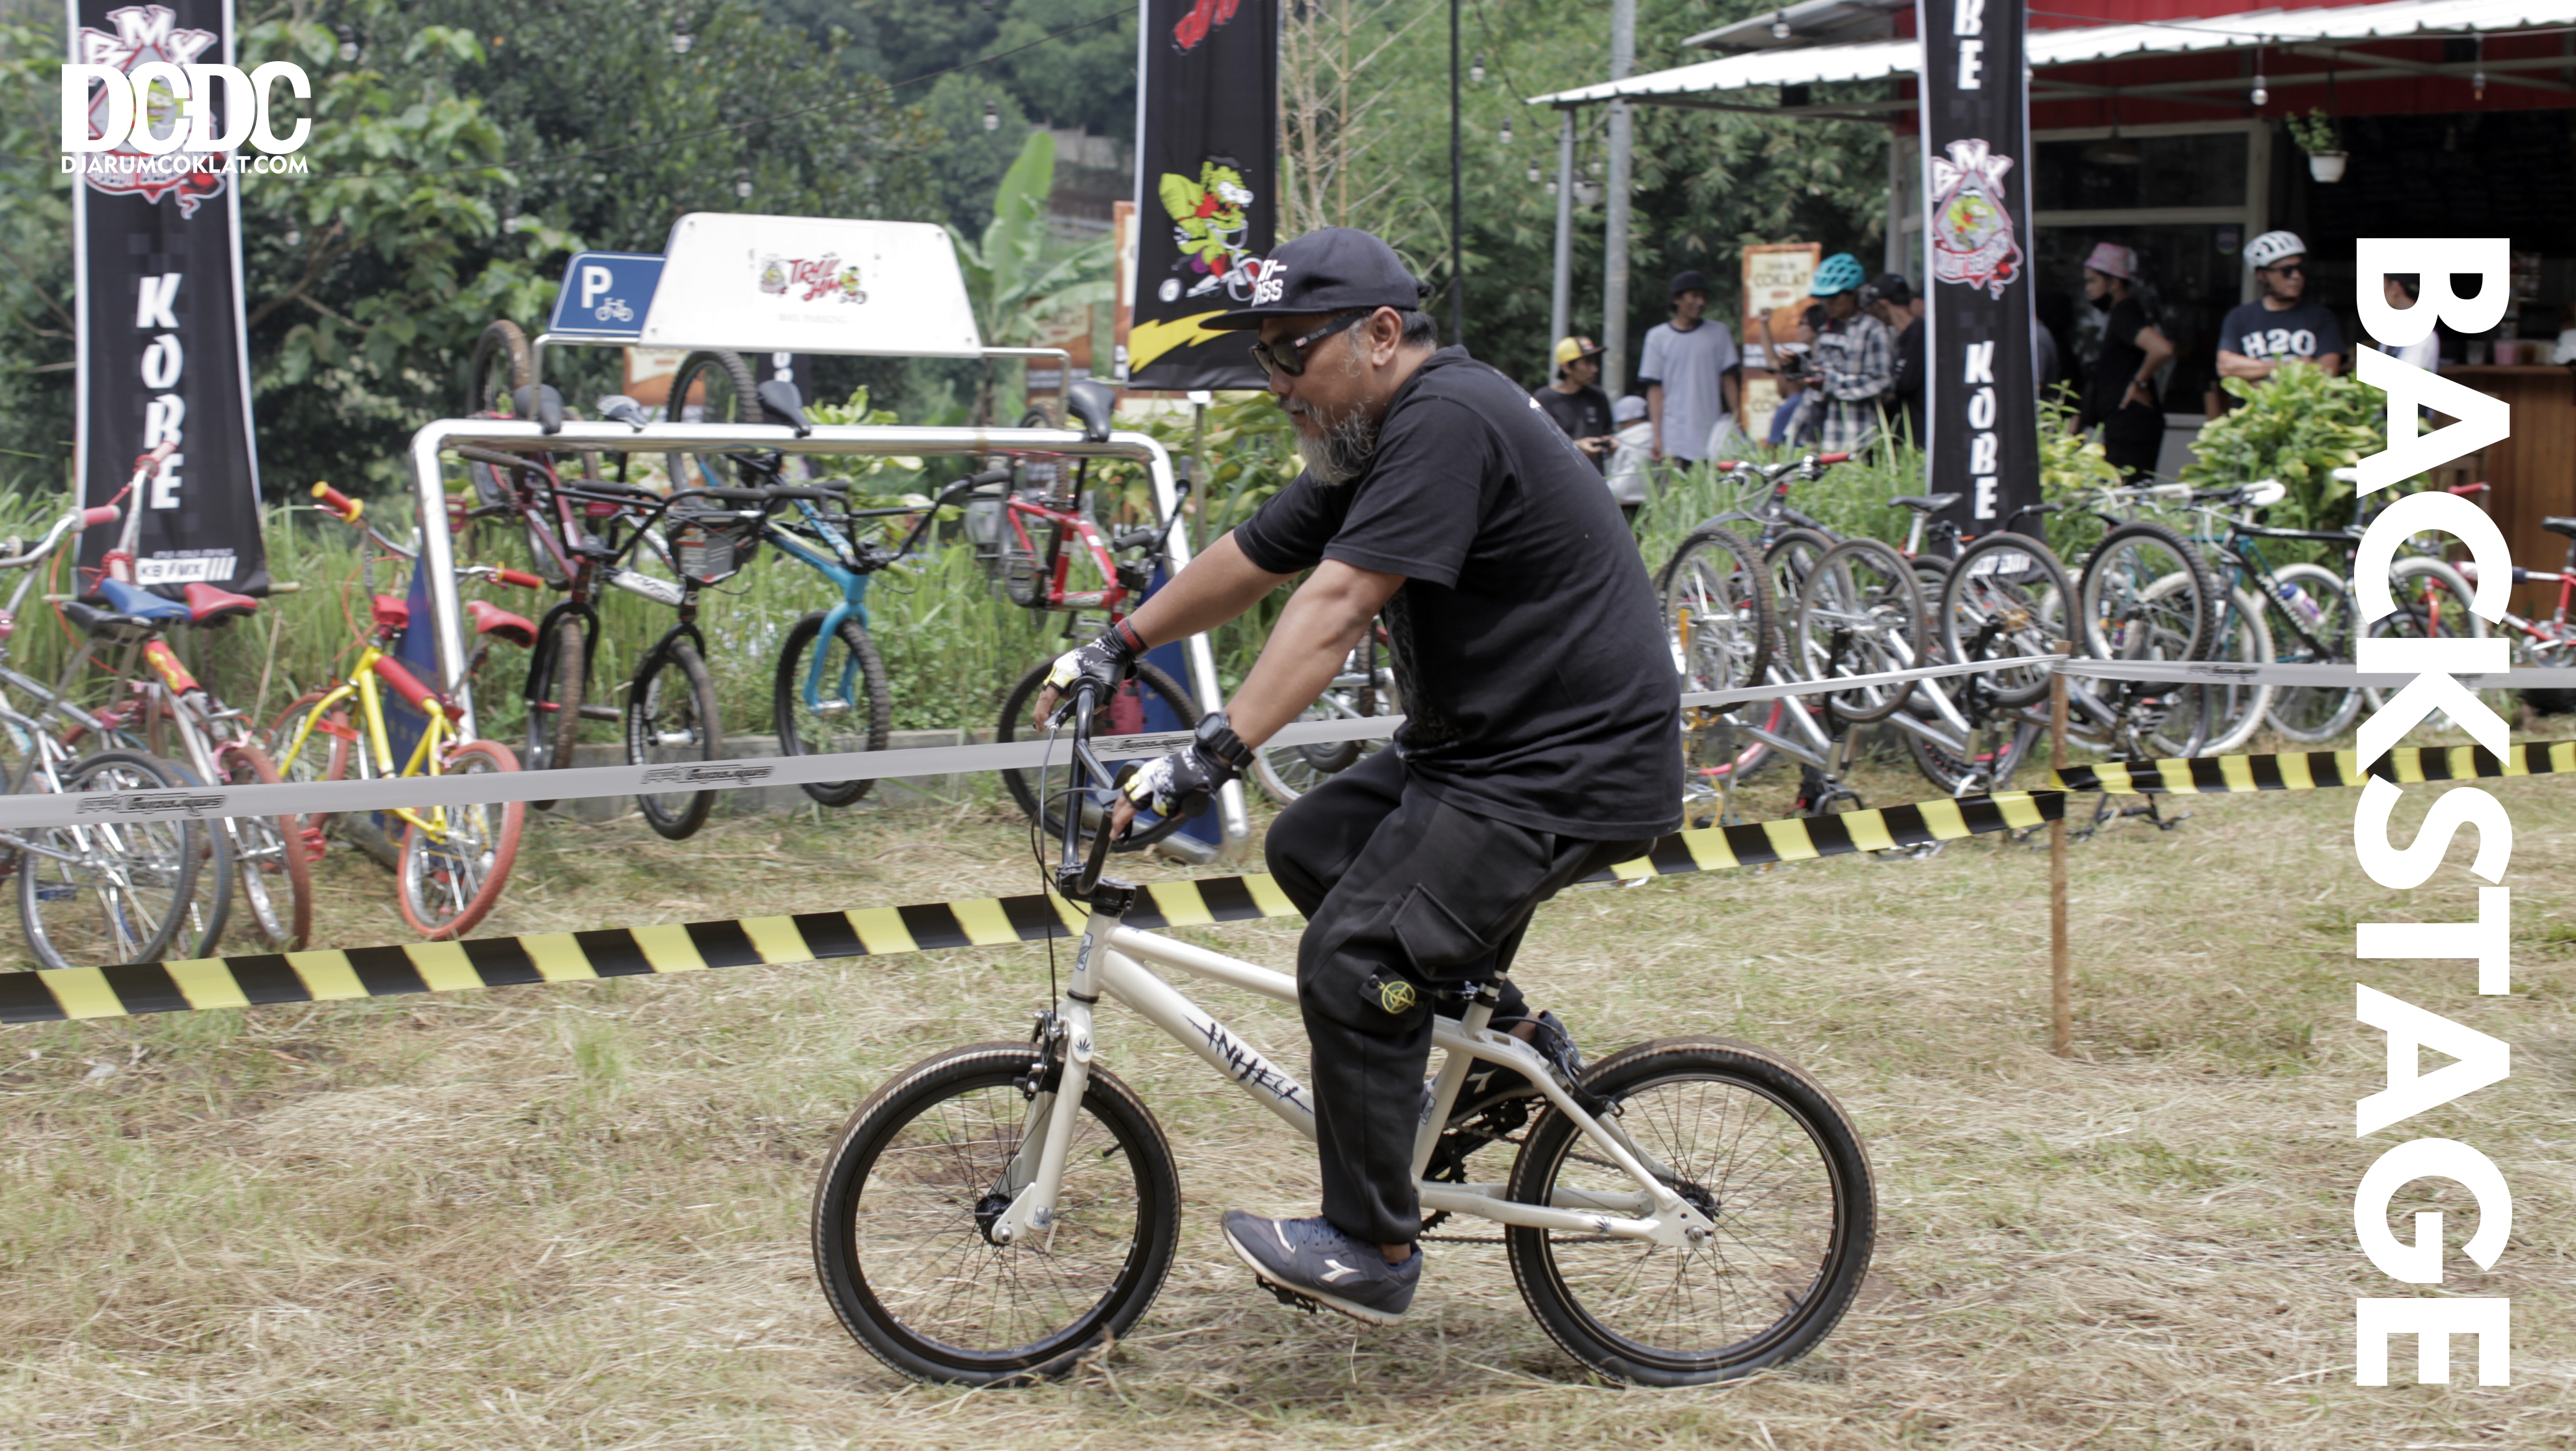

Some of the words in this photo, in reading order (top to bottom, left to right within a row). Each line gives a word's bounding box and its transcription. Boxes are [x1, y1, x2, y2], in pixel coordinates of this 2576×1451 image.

[81, 5, 217, 70] BMX
[1932, 139, 2014, 200] BMX
[581, 266, 612, 309] P
[136, 273, 185, 509] KOBE
[1964, 340, 1998, 519] KOBE
